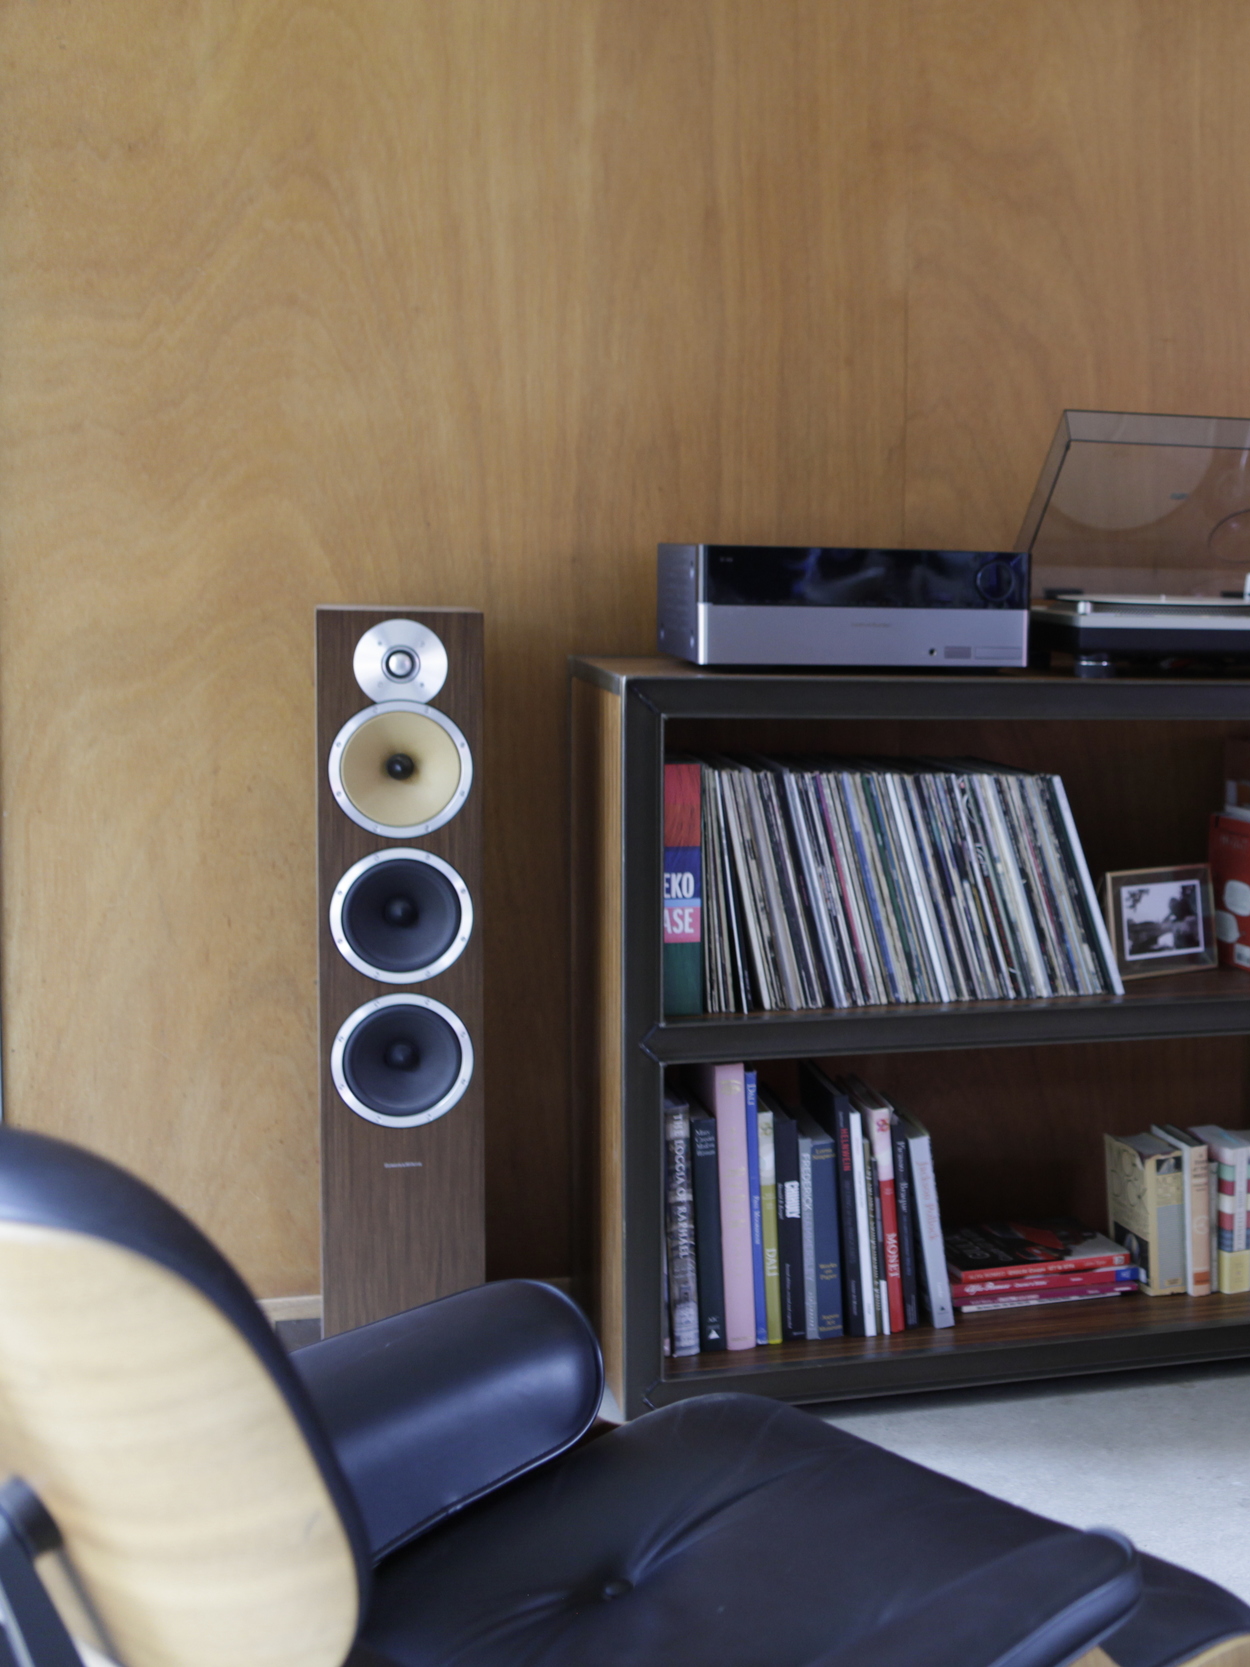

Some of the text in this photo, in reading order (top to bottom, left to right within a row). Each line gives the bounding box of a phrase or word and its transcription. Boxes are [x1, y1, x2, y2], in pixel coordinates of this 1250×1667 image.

[673, 1113, 683, 1137] THE
[840, 1127, 852, 1172] HELNWEIN
[896, 1141, 907, 1172] Picasso
[784, 1180, 801, 1219] CHIHULY
[801, 1152, 813, 1211] FREDERICK
[899, 1181, 909, 1213] Braque
[915, 1161, 931, 1200] Jackson
[924, 1203, 940, 1241] Pollock
[677, 1205, 691, 1259] RAPHAEL
[886, 1232, 901, 1278] MONET
